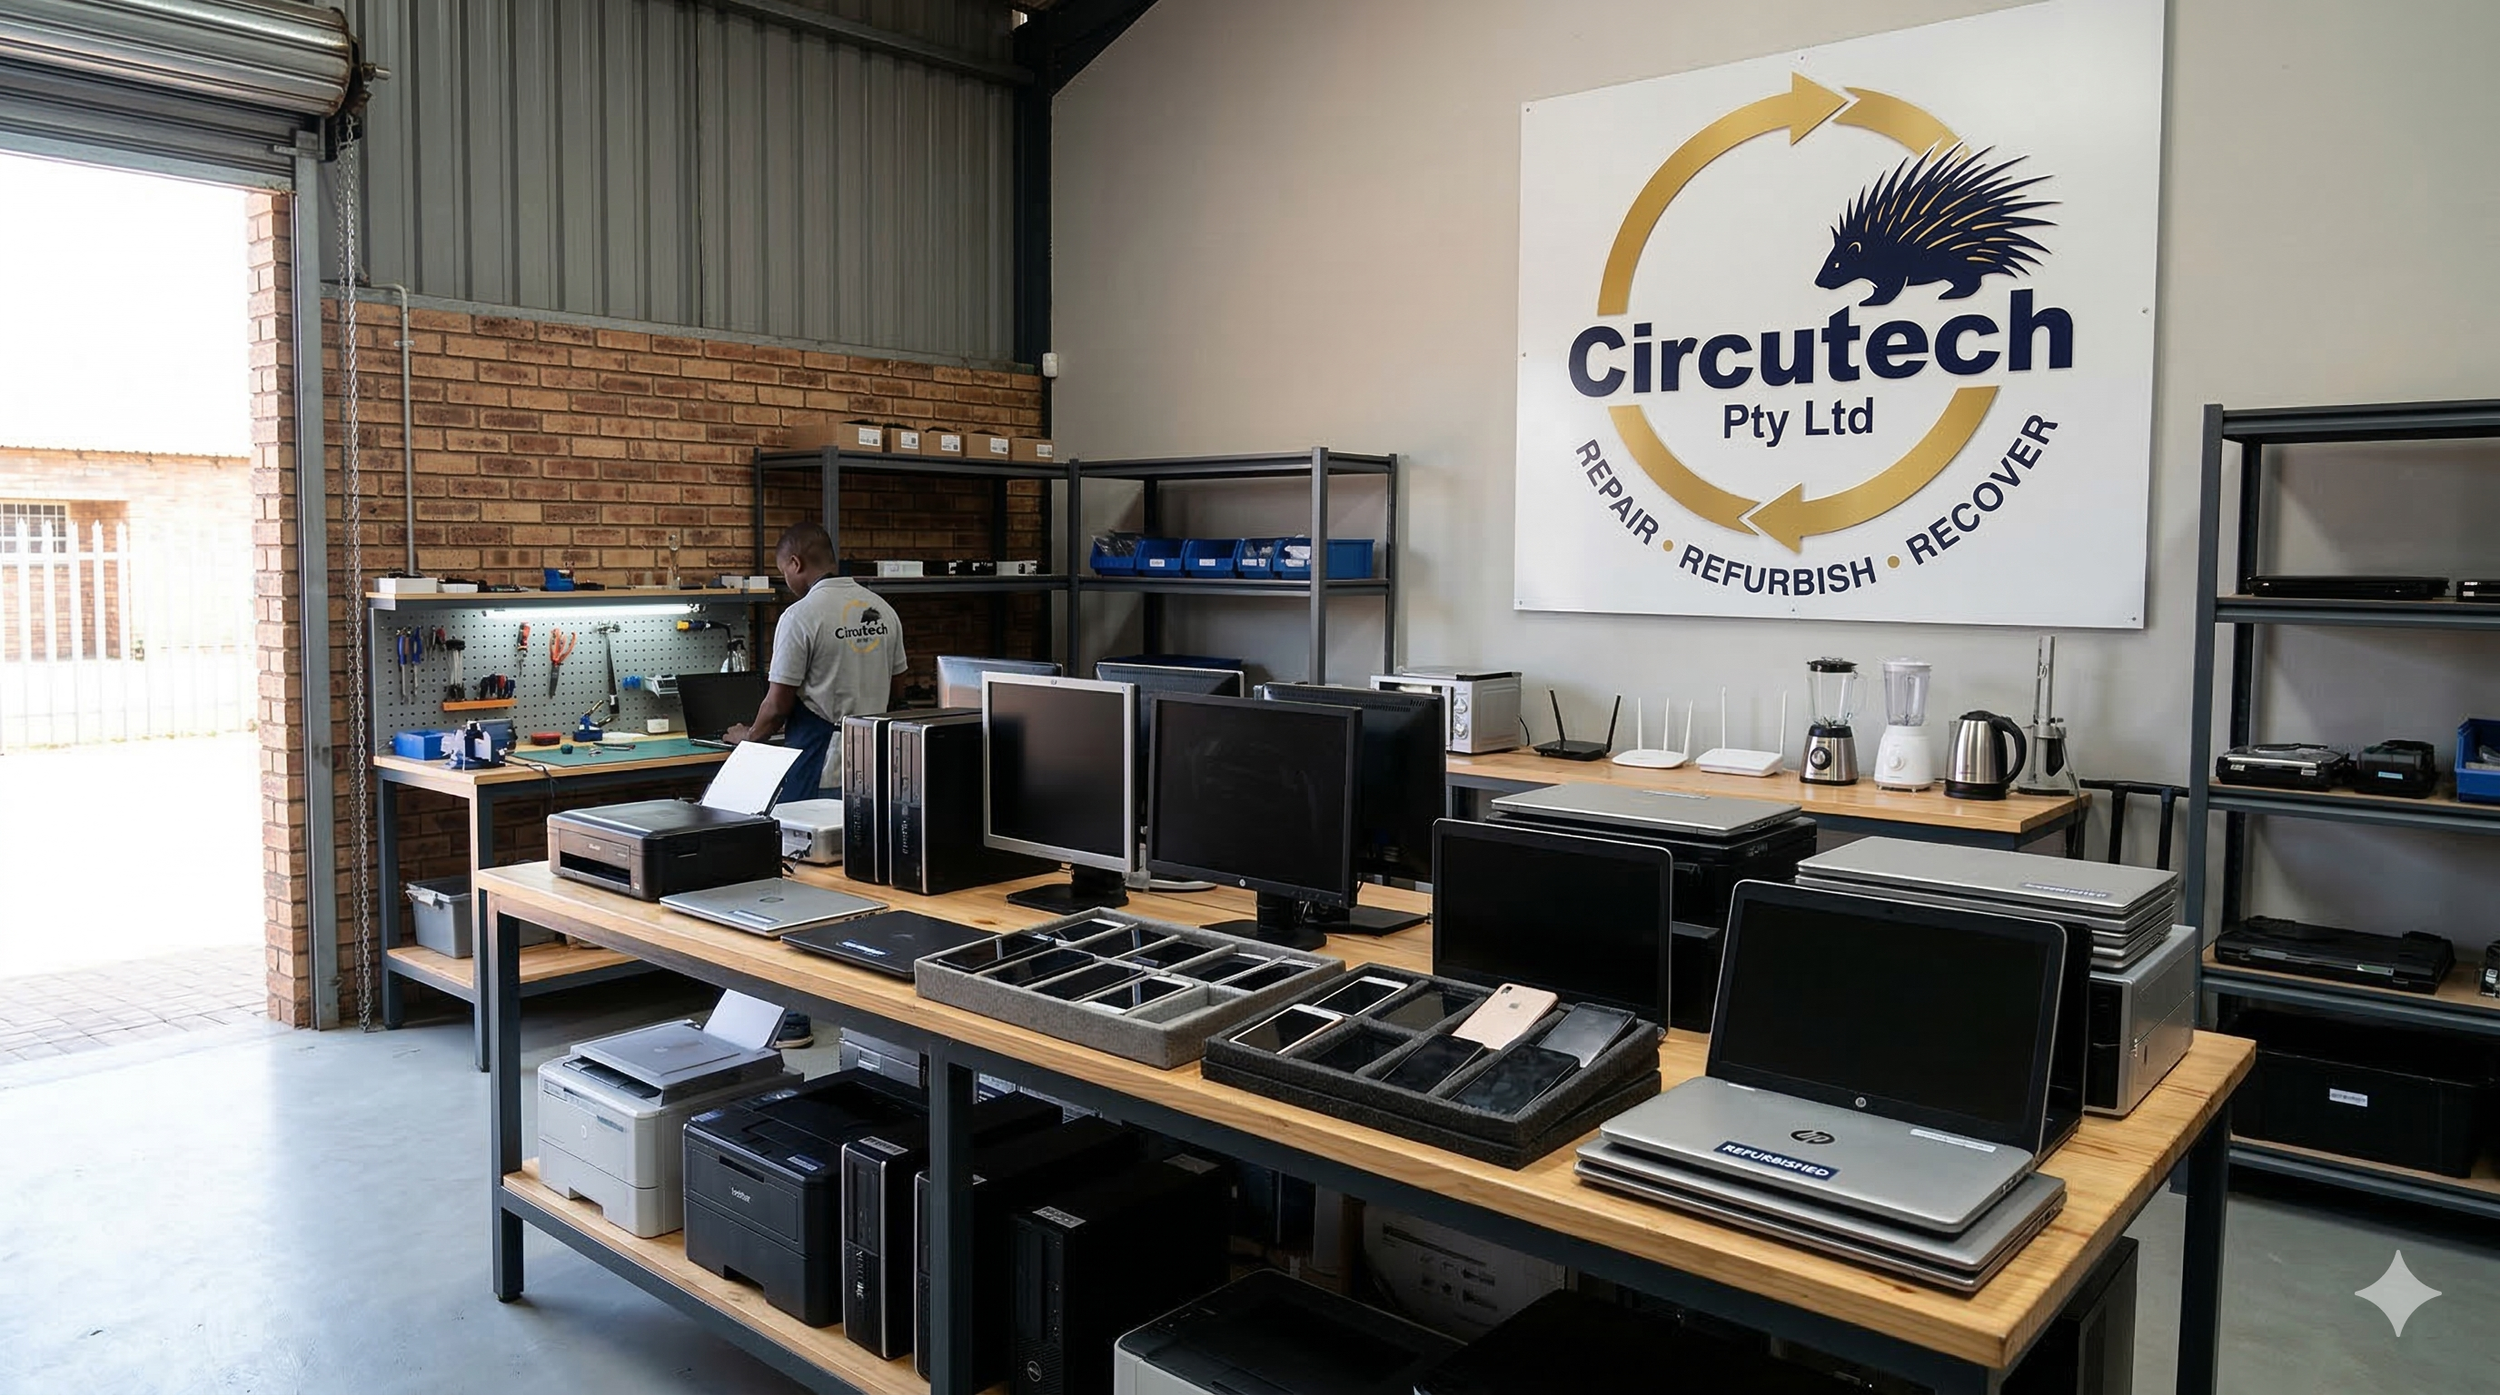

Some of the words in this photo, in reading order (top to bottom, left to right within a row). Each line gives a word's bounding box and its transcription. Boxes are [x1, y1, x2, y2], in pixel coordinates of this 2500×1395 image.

[1568, 288, 2073, 397] Circutech
[1723, 403, 1789, 447] Pty
[1805, 398, 1874, 436] Ltd
[1575, 438, 1659, 546] REPAIR
[1680, 544, 1878, 596] REFURBISH
[1907, 415, 2058, 565] RECOVER
